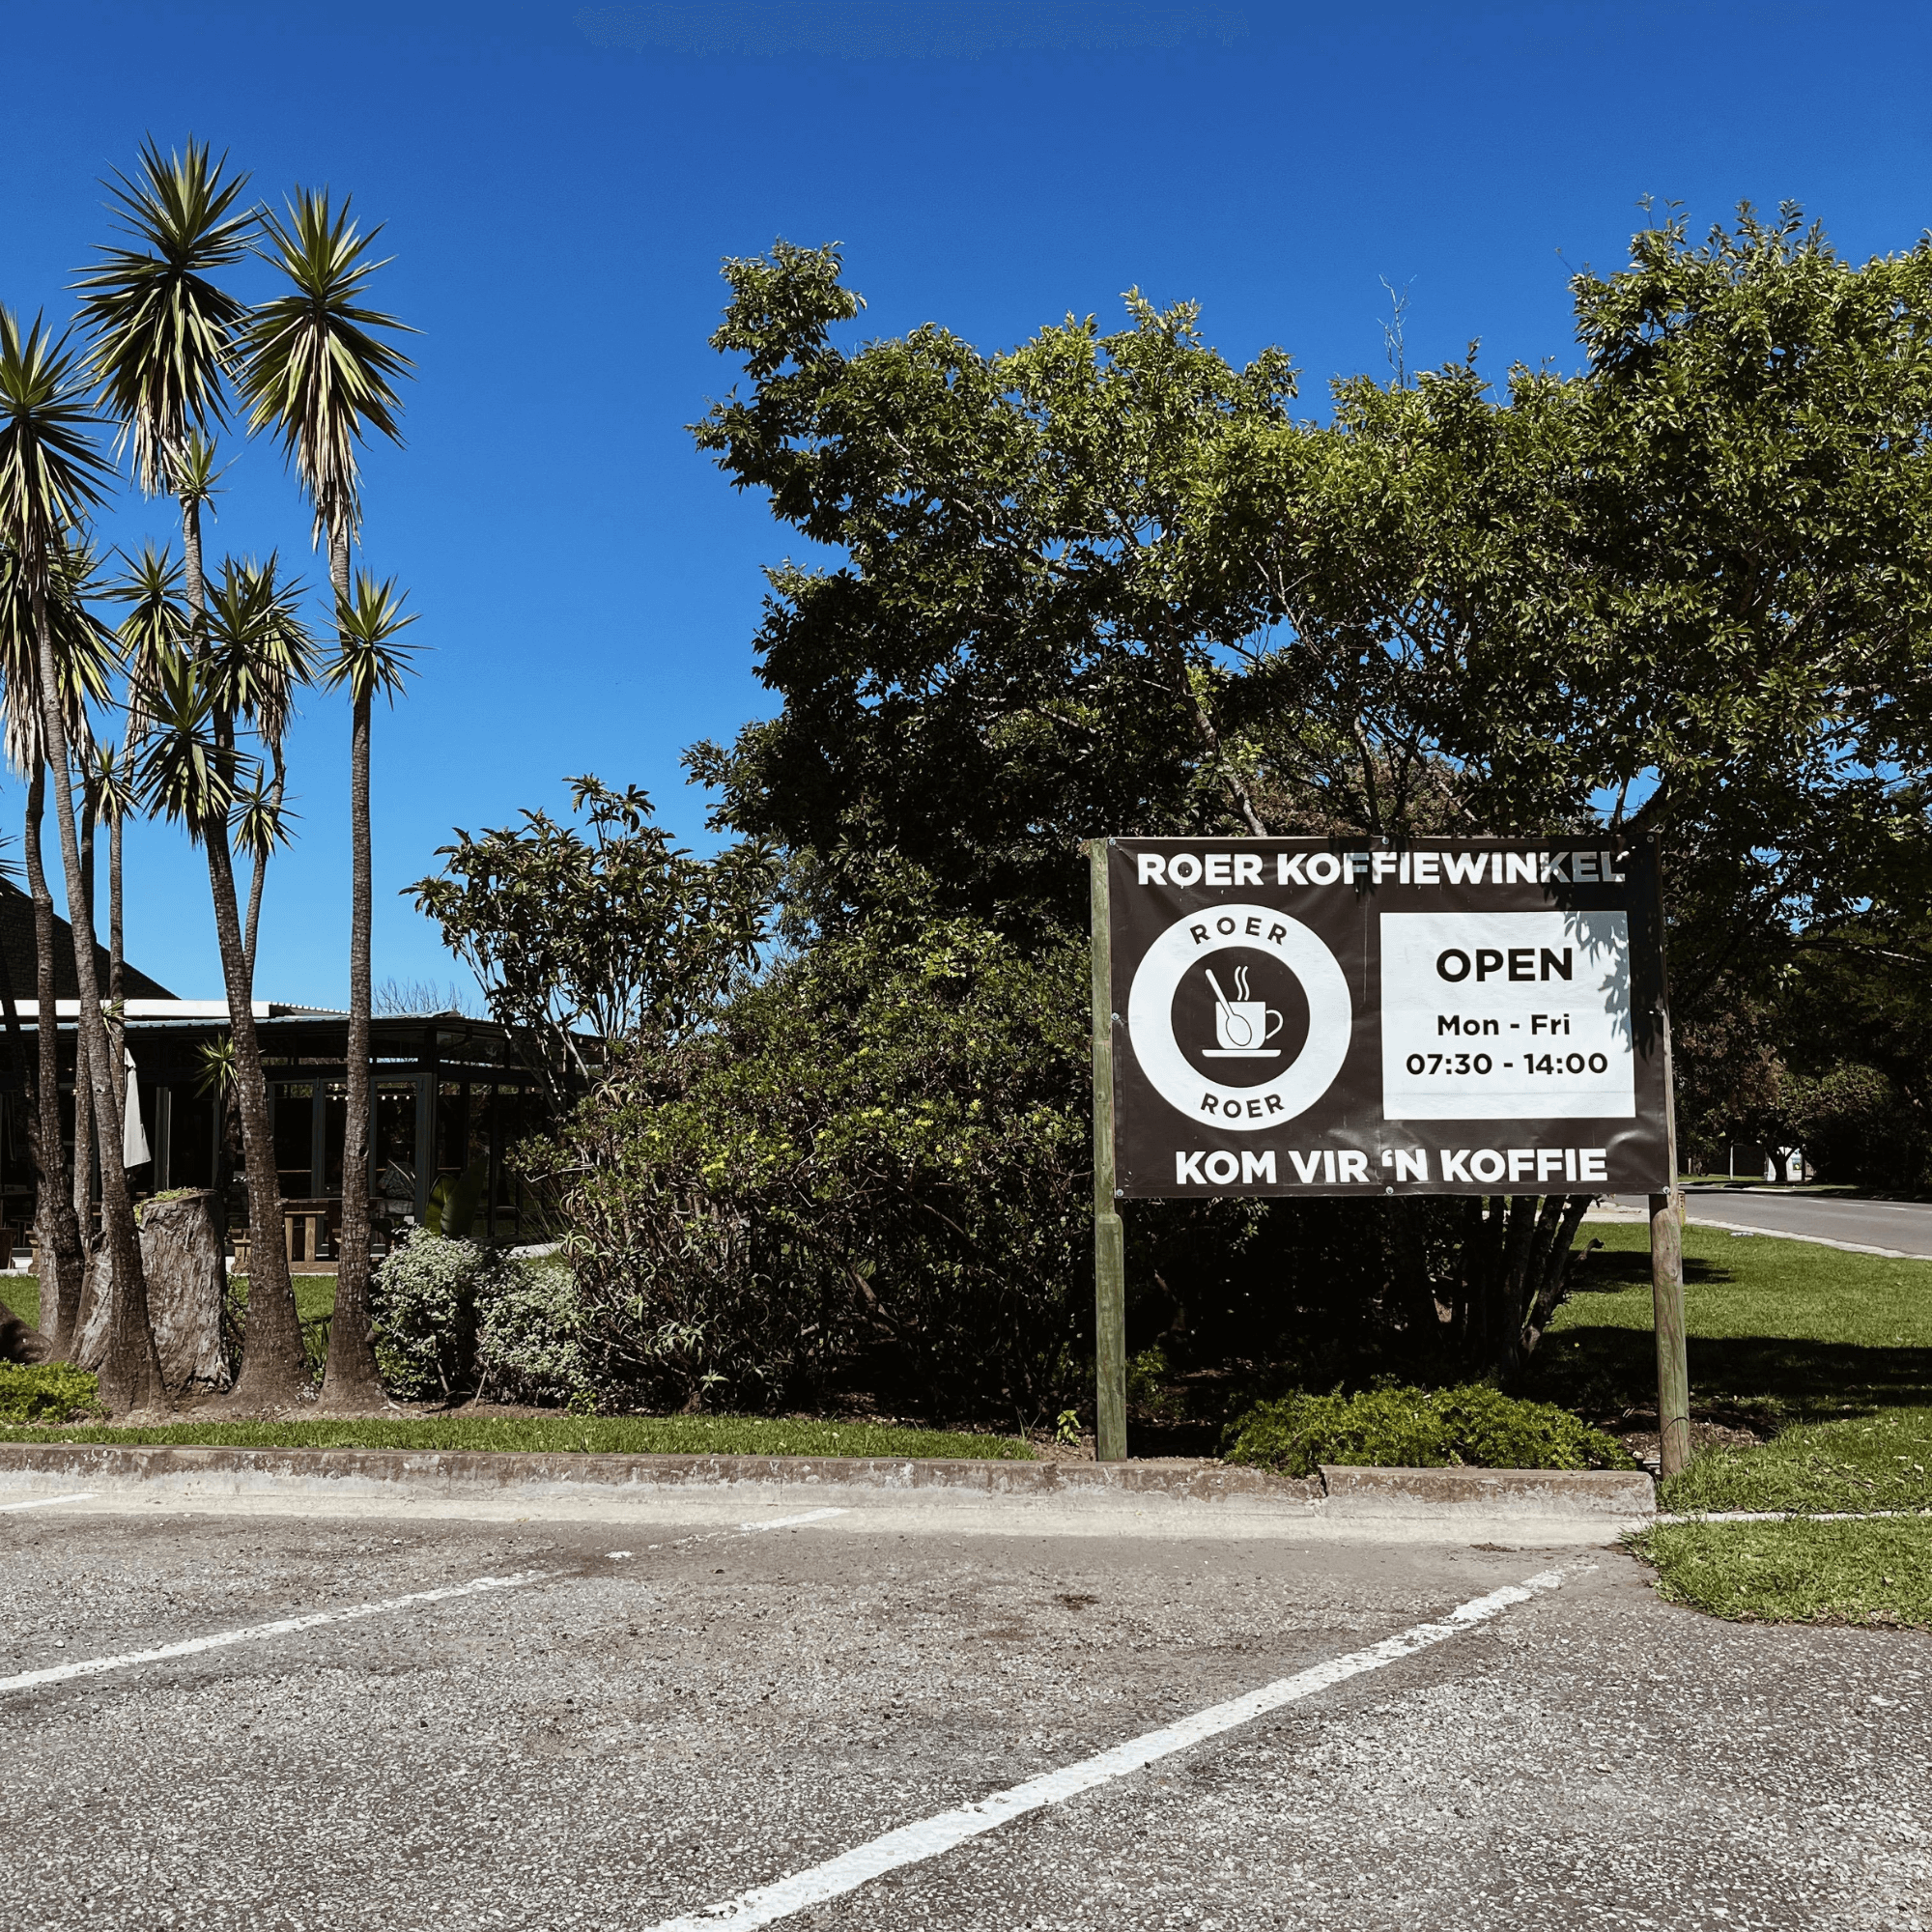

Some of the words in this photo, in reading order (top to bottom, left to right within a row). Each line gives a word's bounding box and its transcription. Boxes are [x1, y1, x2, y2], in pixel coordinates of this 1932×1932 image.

[1137, 853, 1264, 886] ROER
[1277, 851, 1626, 886] KOFFIEWINKEL
[1189, 916, 1288, 946] ROER
[1436, 948, 1573, 983] OPEN
[1437, 1014, 1499, 1036] Mon
[1531, 1013, 1570, 1036] Fri
[1406, 1053, 1492, 1075] 07:30
[1523, 1052, 1608, 1075] 14:00
[1200, 1092, 1285, 1119] ROER
[1176, 1150, 1277, 1185] KOM
[1288, 1150, 1371, 1184] VIR
[1439, 1148, 1608, 1183] KOFFIE
